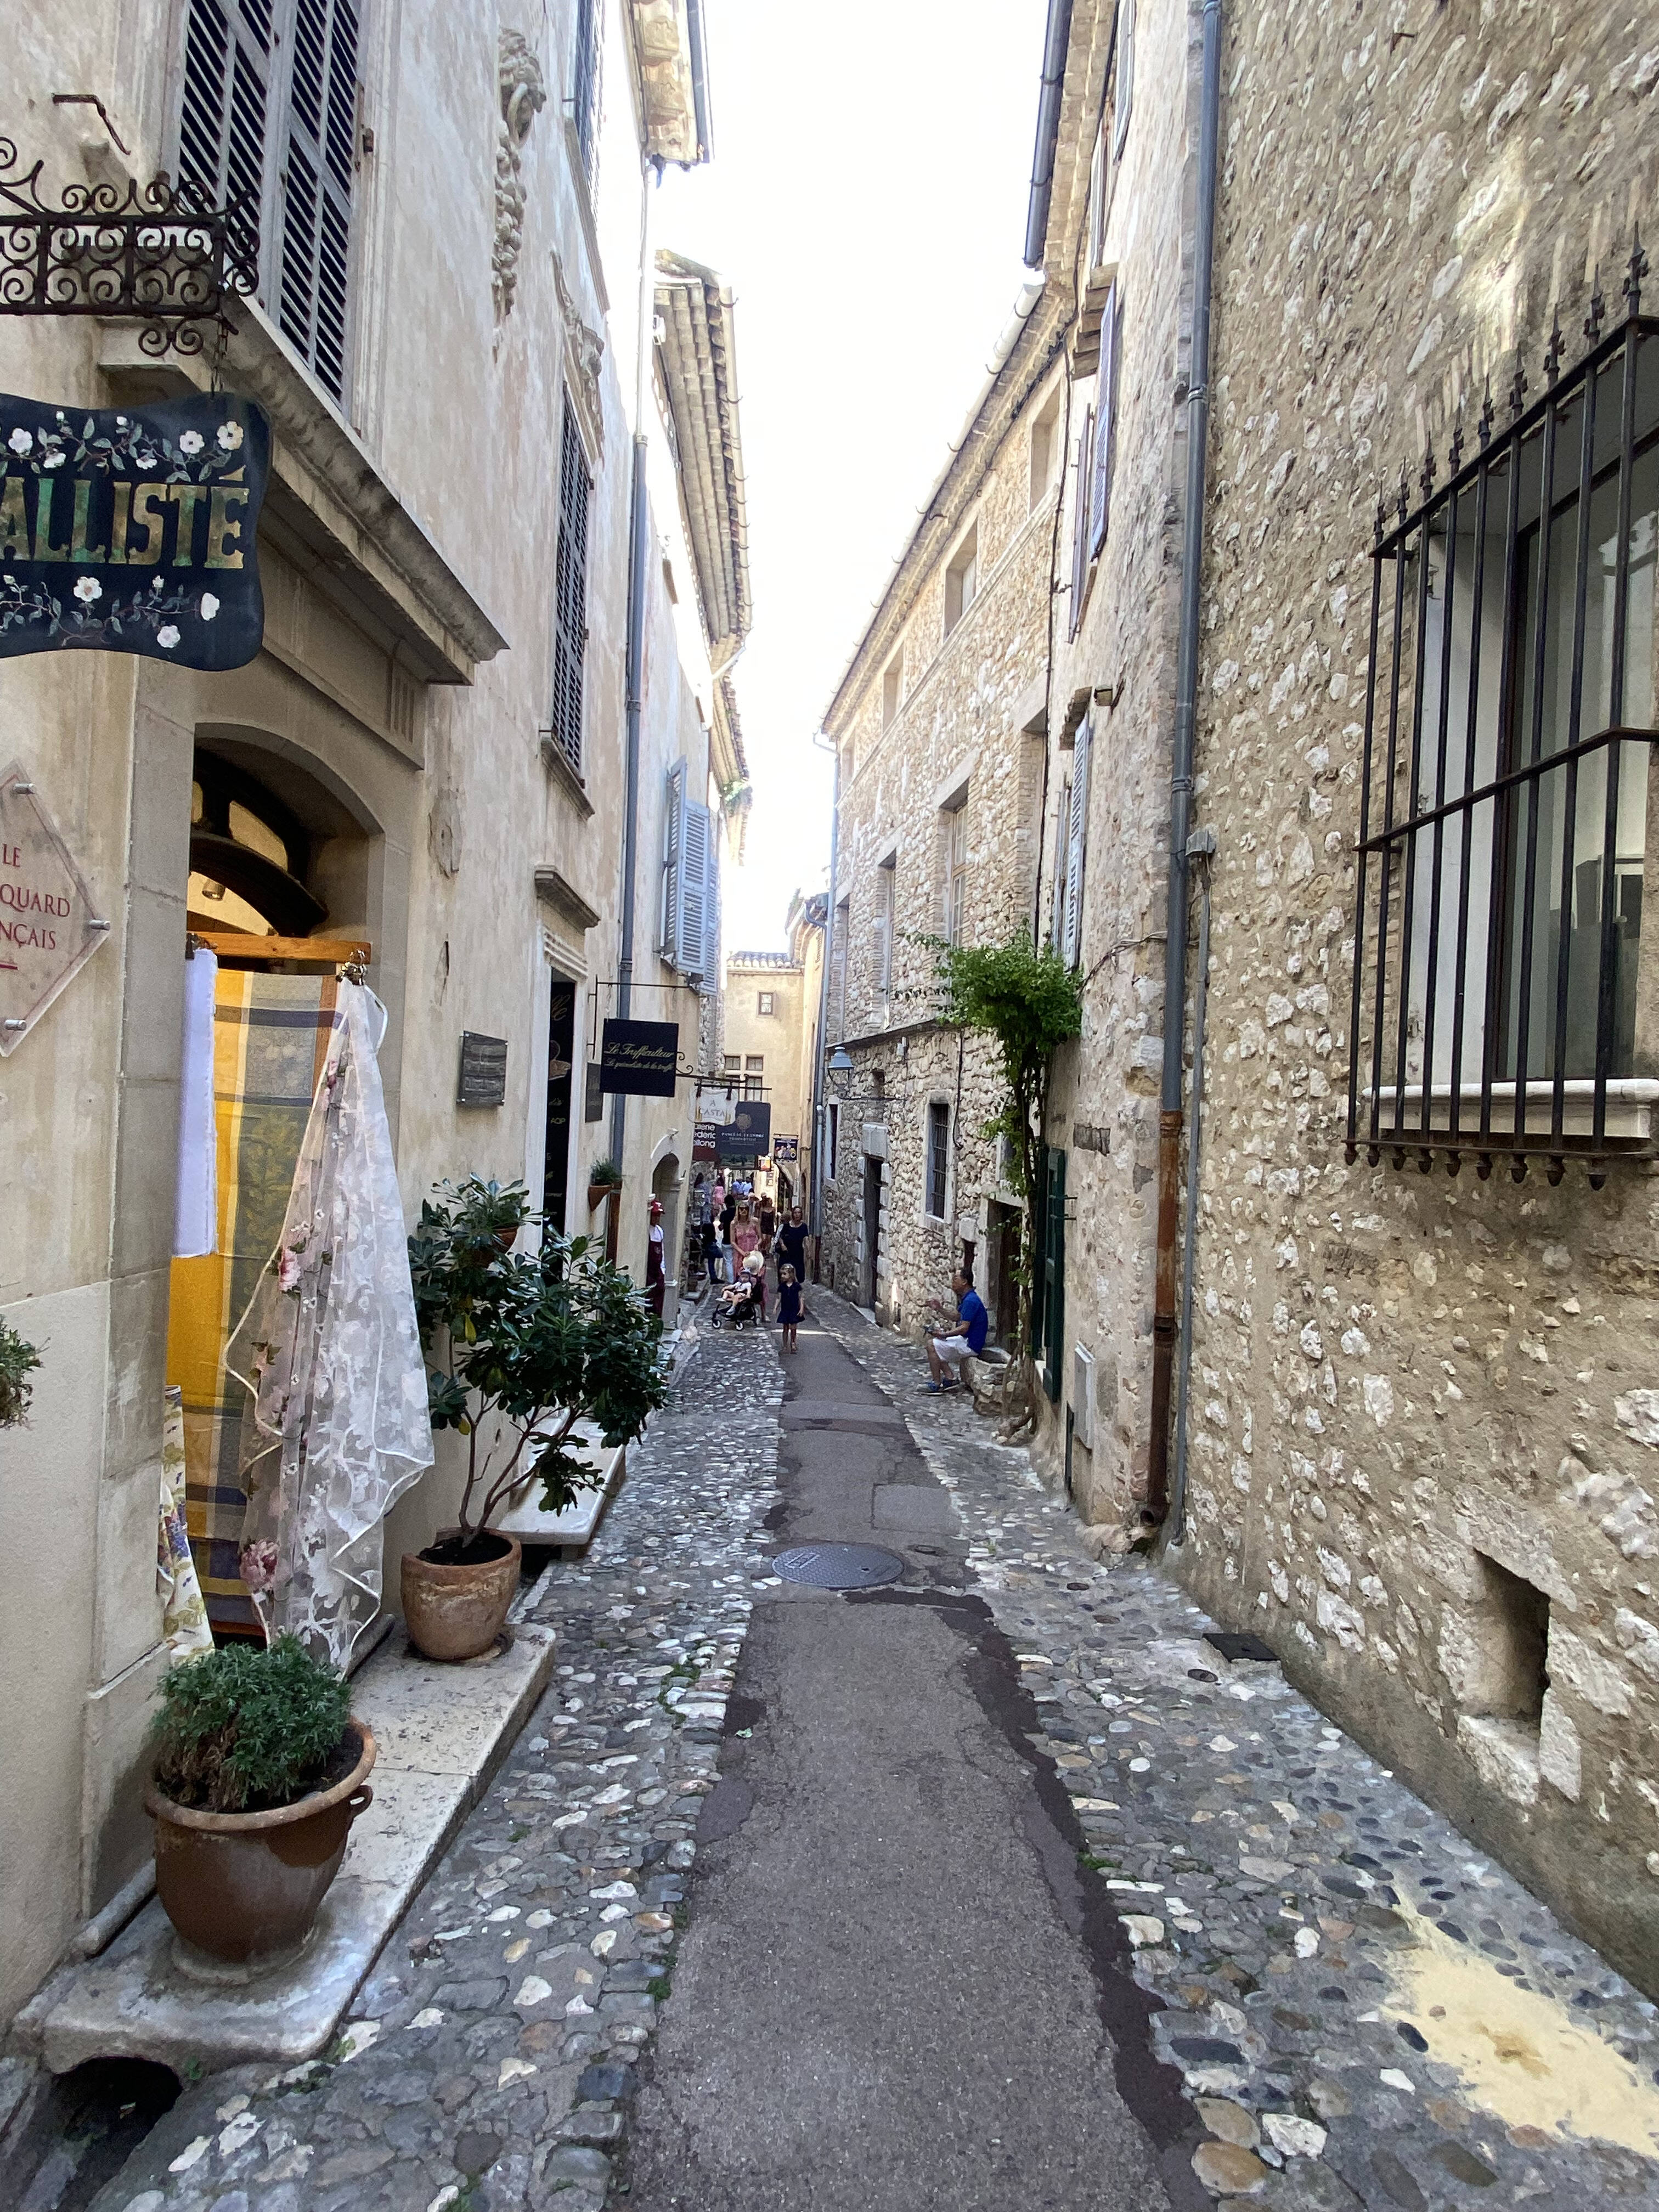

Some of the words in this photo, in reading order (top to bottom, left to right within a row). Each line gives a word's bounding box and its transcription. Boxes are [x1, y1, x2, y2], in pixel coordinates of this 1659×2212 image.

[2, 843, 21, 867] LE
[0, 883, 70, 917] QUARD
[603, 1042, 620, 1054] Le
